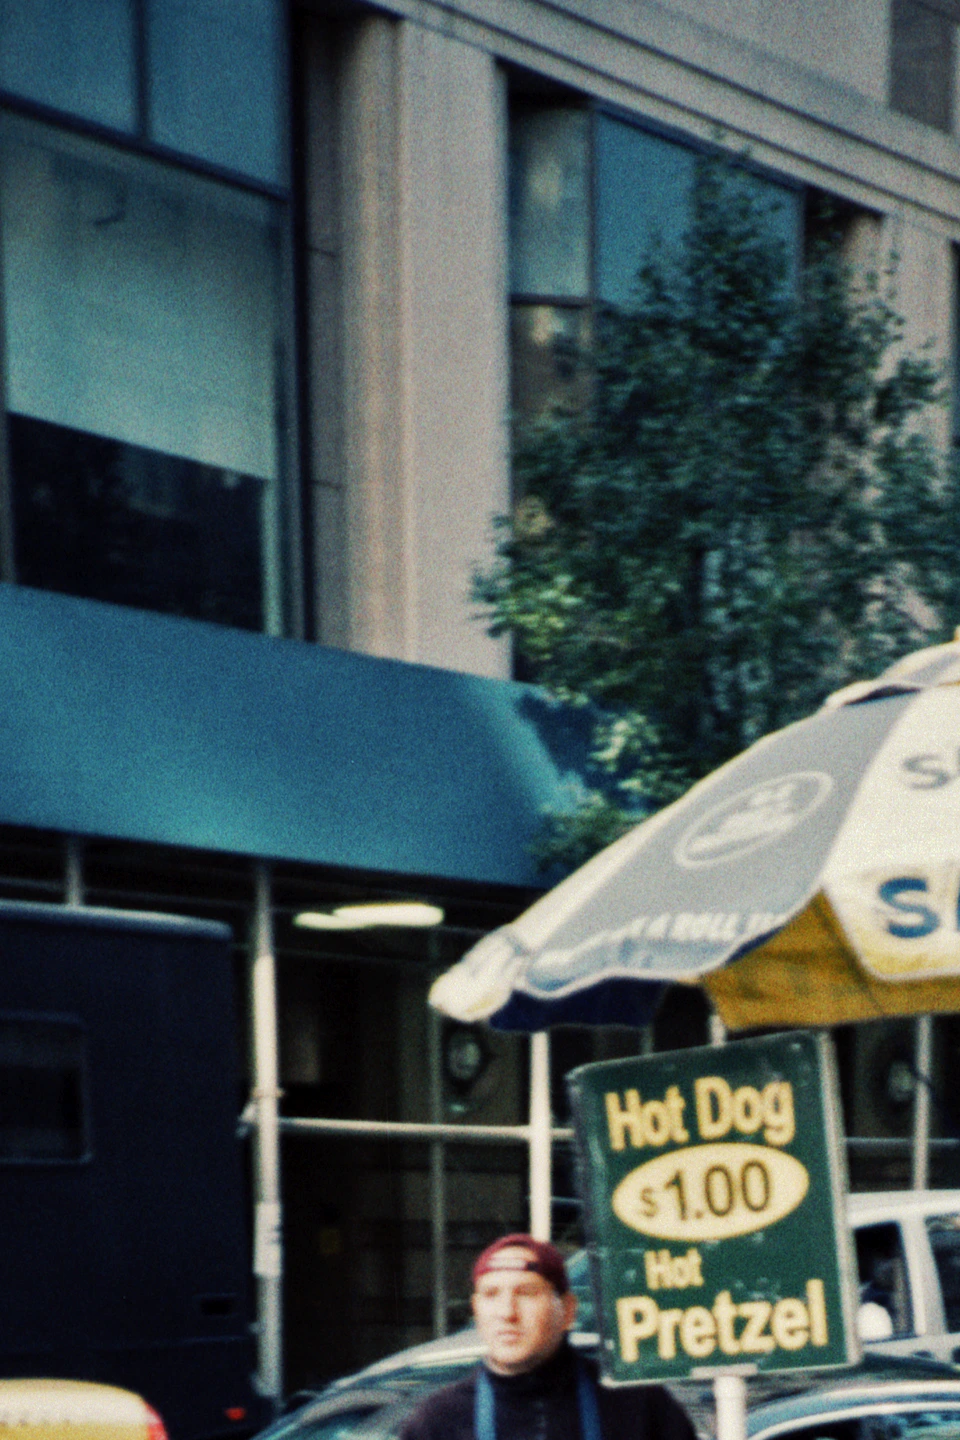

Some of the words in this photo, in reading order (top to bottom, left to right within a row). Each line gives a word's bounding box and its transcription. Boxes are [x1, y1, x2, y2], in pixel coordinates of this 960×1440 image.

[604, 1085, 689, 1151] Hot
[694, 1076, 796, 1146] Dog
[639, 1159, 771, 1221] $1.00
[644, 1248, 704, 1289] Hot
[616, 1278, 828, 1362] Pretzel
